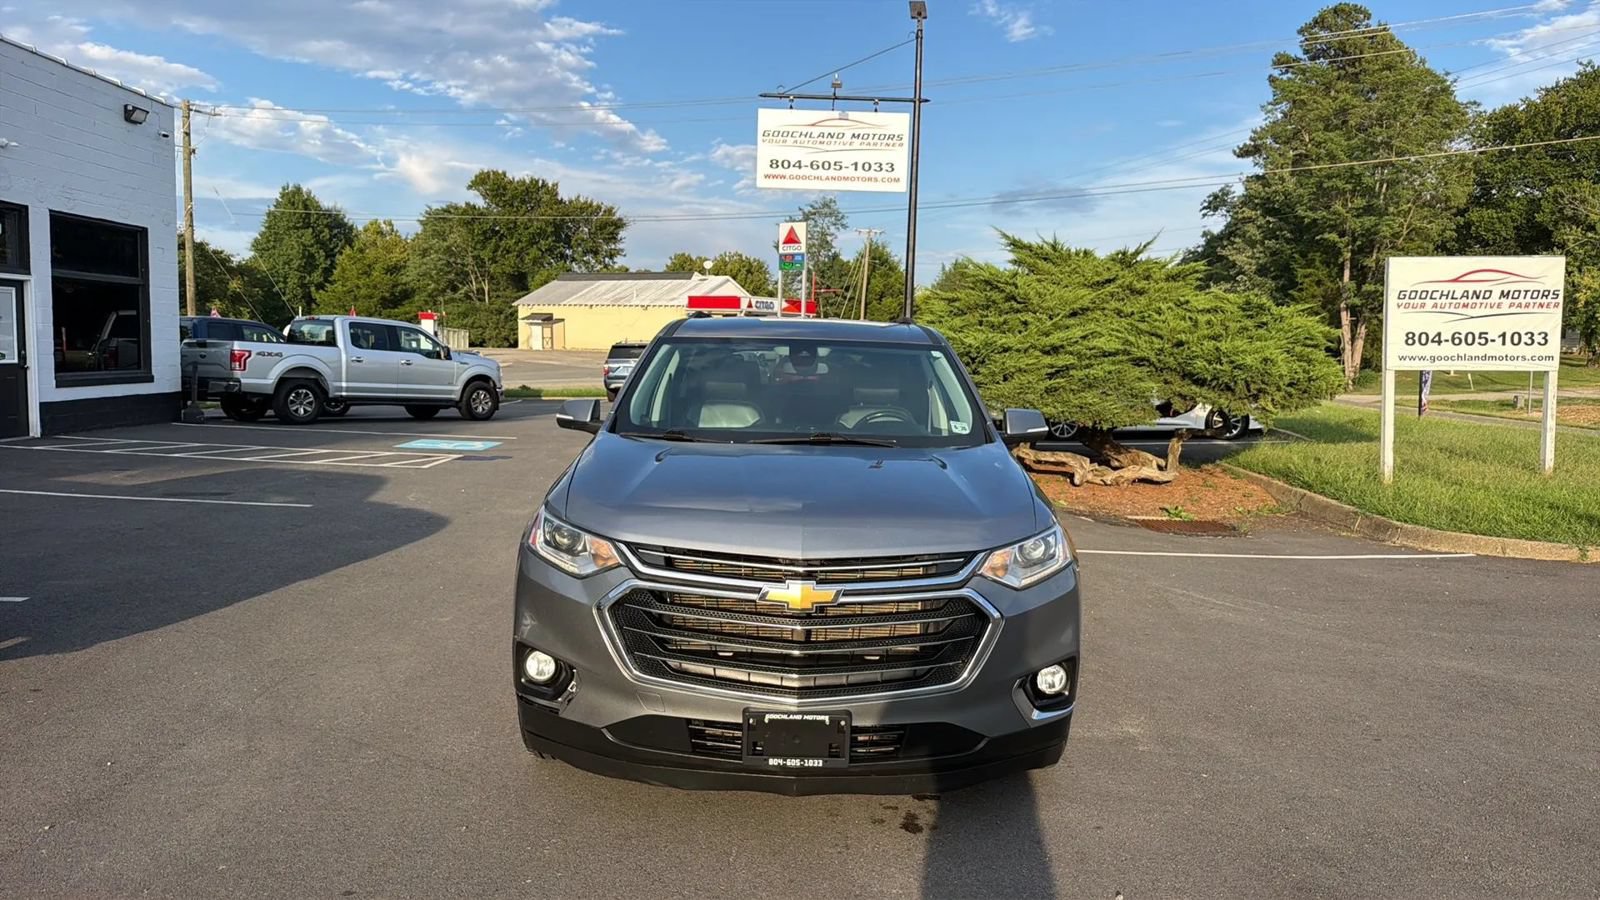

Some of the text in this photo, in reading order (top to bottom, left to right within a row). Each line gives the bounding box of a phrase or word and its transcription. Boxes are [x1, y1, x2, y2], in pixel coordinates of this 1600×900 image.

[762, 130, 904, 141] GOOCHLAND MOTORS
[769, 158, 895, 172] 804-605-1033
[764, 173, 900, 184] WWW.GOOCHLANDMOTORS.COM
[1397, 289, 1560, 300] GOOCHLAND MOTORS
[754, 300, 775, 310] CITGO
[1431, 302, 1504, 310] AUTOMOTIVE
[1508, 301, 1560, 309] PARTNER
[1404, 331, 1549, 346] 804-605-1033
[1398, 353, 1554, 364] www.goochlandmotors.com
[768, 758, 823, 767] 804-605-1033
